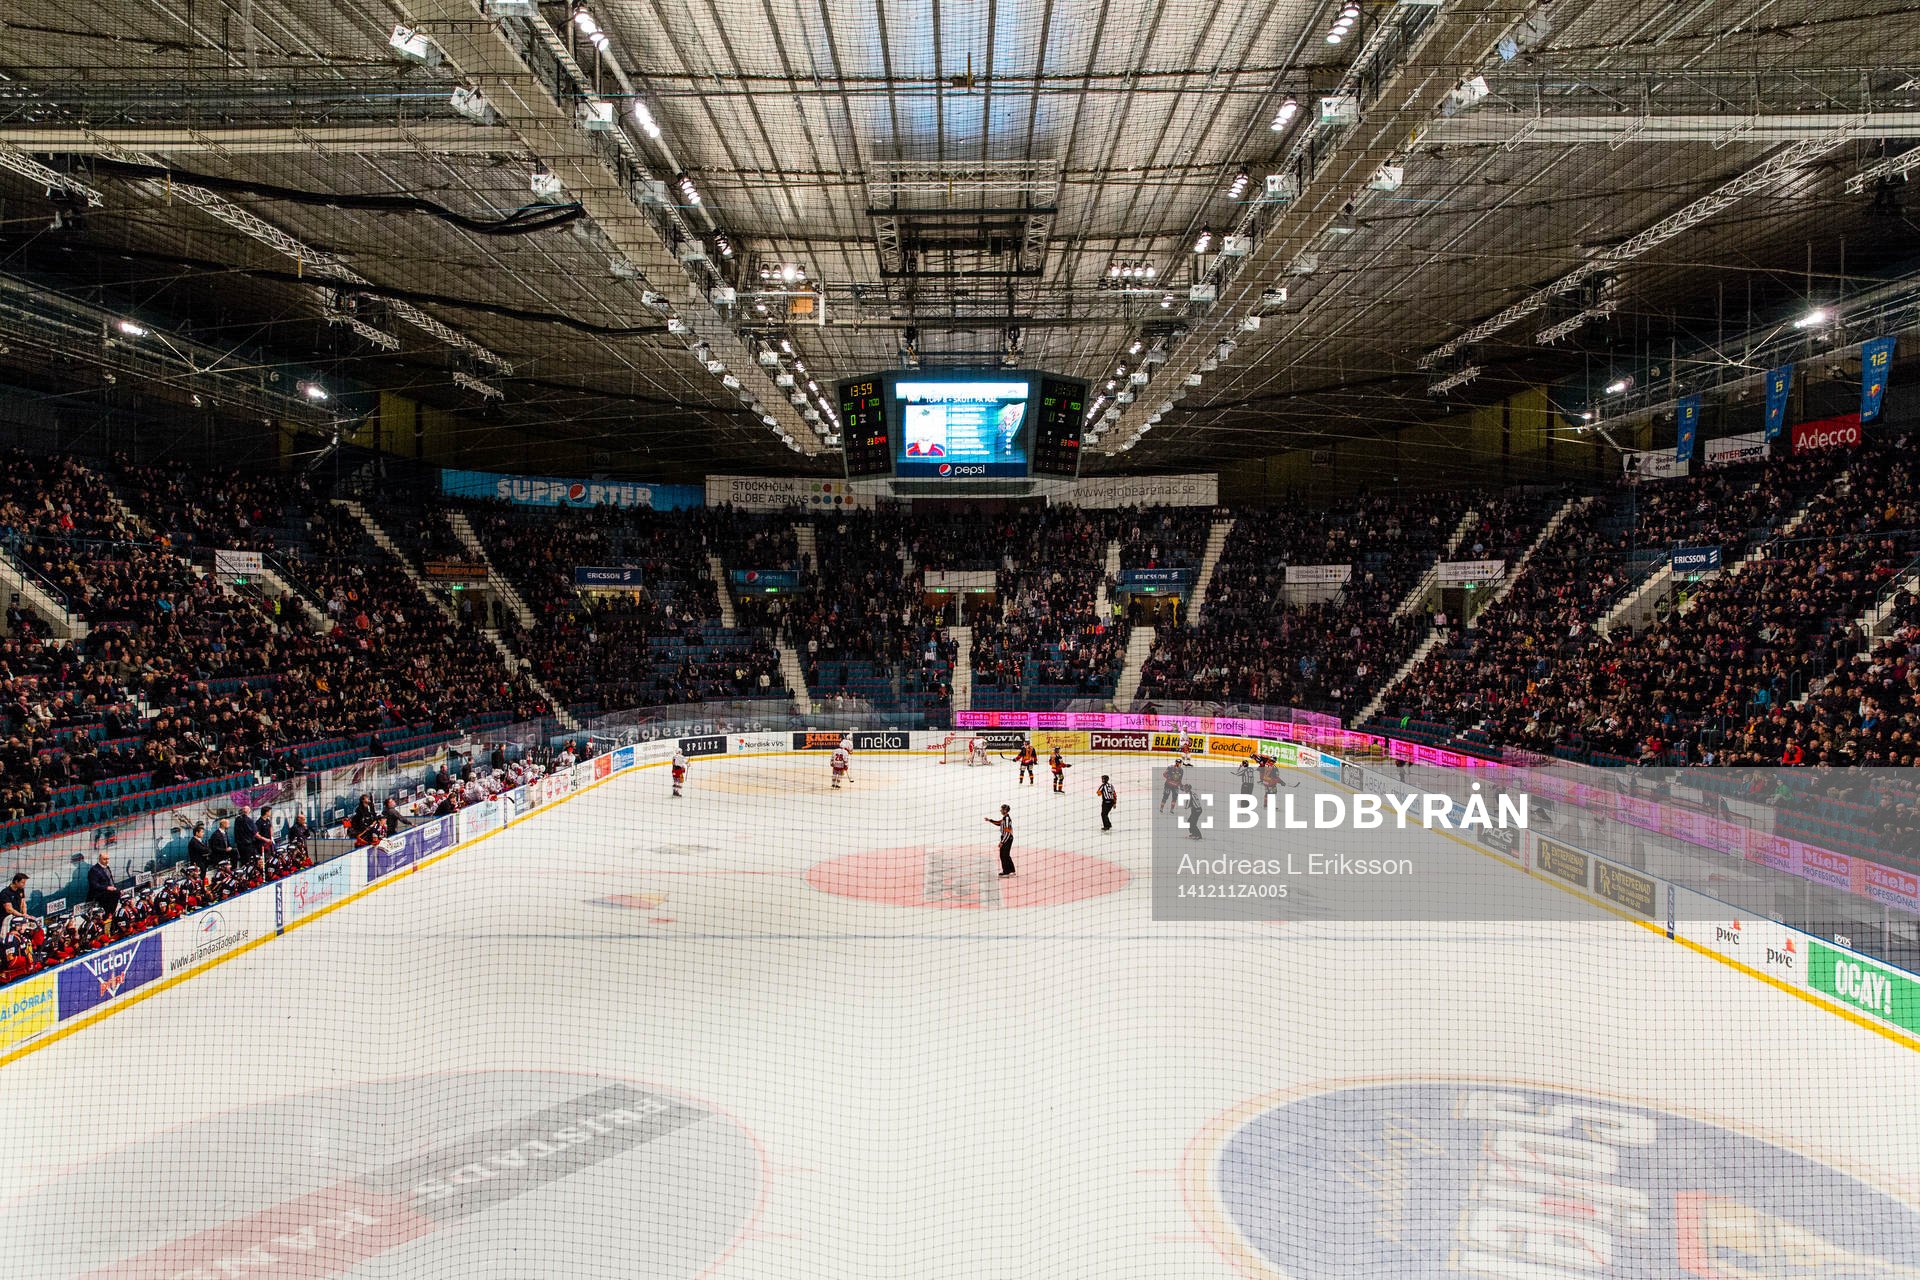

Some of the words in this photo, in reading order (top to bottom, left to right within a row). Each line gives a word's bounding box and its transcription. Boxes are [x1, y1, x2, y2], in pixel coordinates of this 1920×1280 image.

[1871, 351, 1888, 367] 12
[850, 382, 873, 397] 13:59
[1775, 380, 1784, 393] 5
[850, 414, 857, 426] 0
[1686, 407, 1693, 418] 2
[1797, 427, 1857, 450] Adecco
[1716, 445, 1764, 462] INTERSPORT
[954, 465, 985, 476] pepsi
[1655, 463, 1671, 471] Kraft
[496, 478, 652, 508] SUPPORTER
[732, 481, 793, 492] STOCKHOLM
[1072, 483, 1196, 500] www.globearenas.se
[732, 493, 764, 504] GLOBE
[767, 494, 809, 505] ARENAS
[1674, 554, 1706, 564] ERICSSON
[586, 571, 621, 581] ERICSSON
[1134, 572, 1168, 581] ERICSSON
[1200, 719, 1214, 729] för
[1264, 723, 1289, 732] Miele
[805, 733, 842, 741] KAKEL
[860, 733, 902, 749] ineko
[1092, 734, 1147, 749] Prioritet
[1211, 741, 1252, 754] GoodCash
[1803, 847, 1851, 874] Miele
[1611, 870, 1651, 896] ENTREPRENAD
[1802, 864, 1850, 888] PROFESSIONAL
[1865, 864, 1918, 895] Miele
[1864, 883, 1919, 910] PROFESSIONAL
[1716, 926, 1740, 945] pwc
[83, 940, 141, 977] Victory
[1767, 948, 1793, 968] pwc
[1834, 959, 1892, 1015] OCAY!
